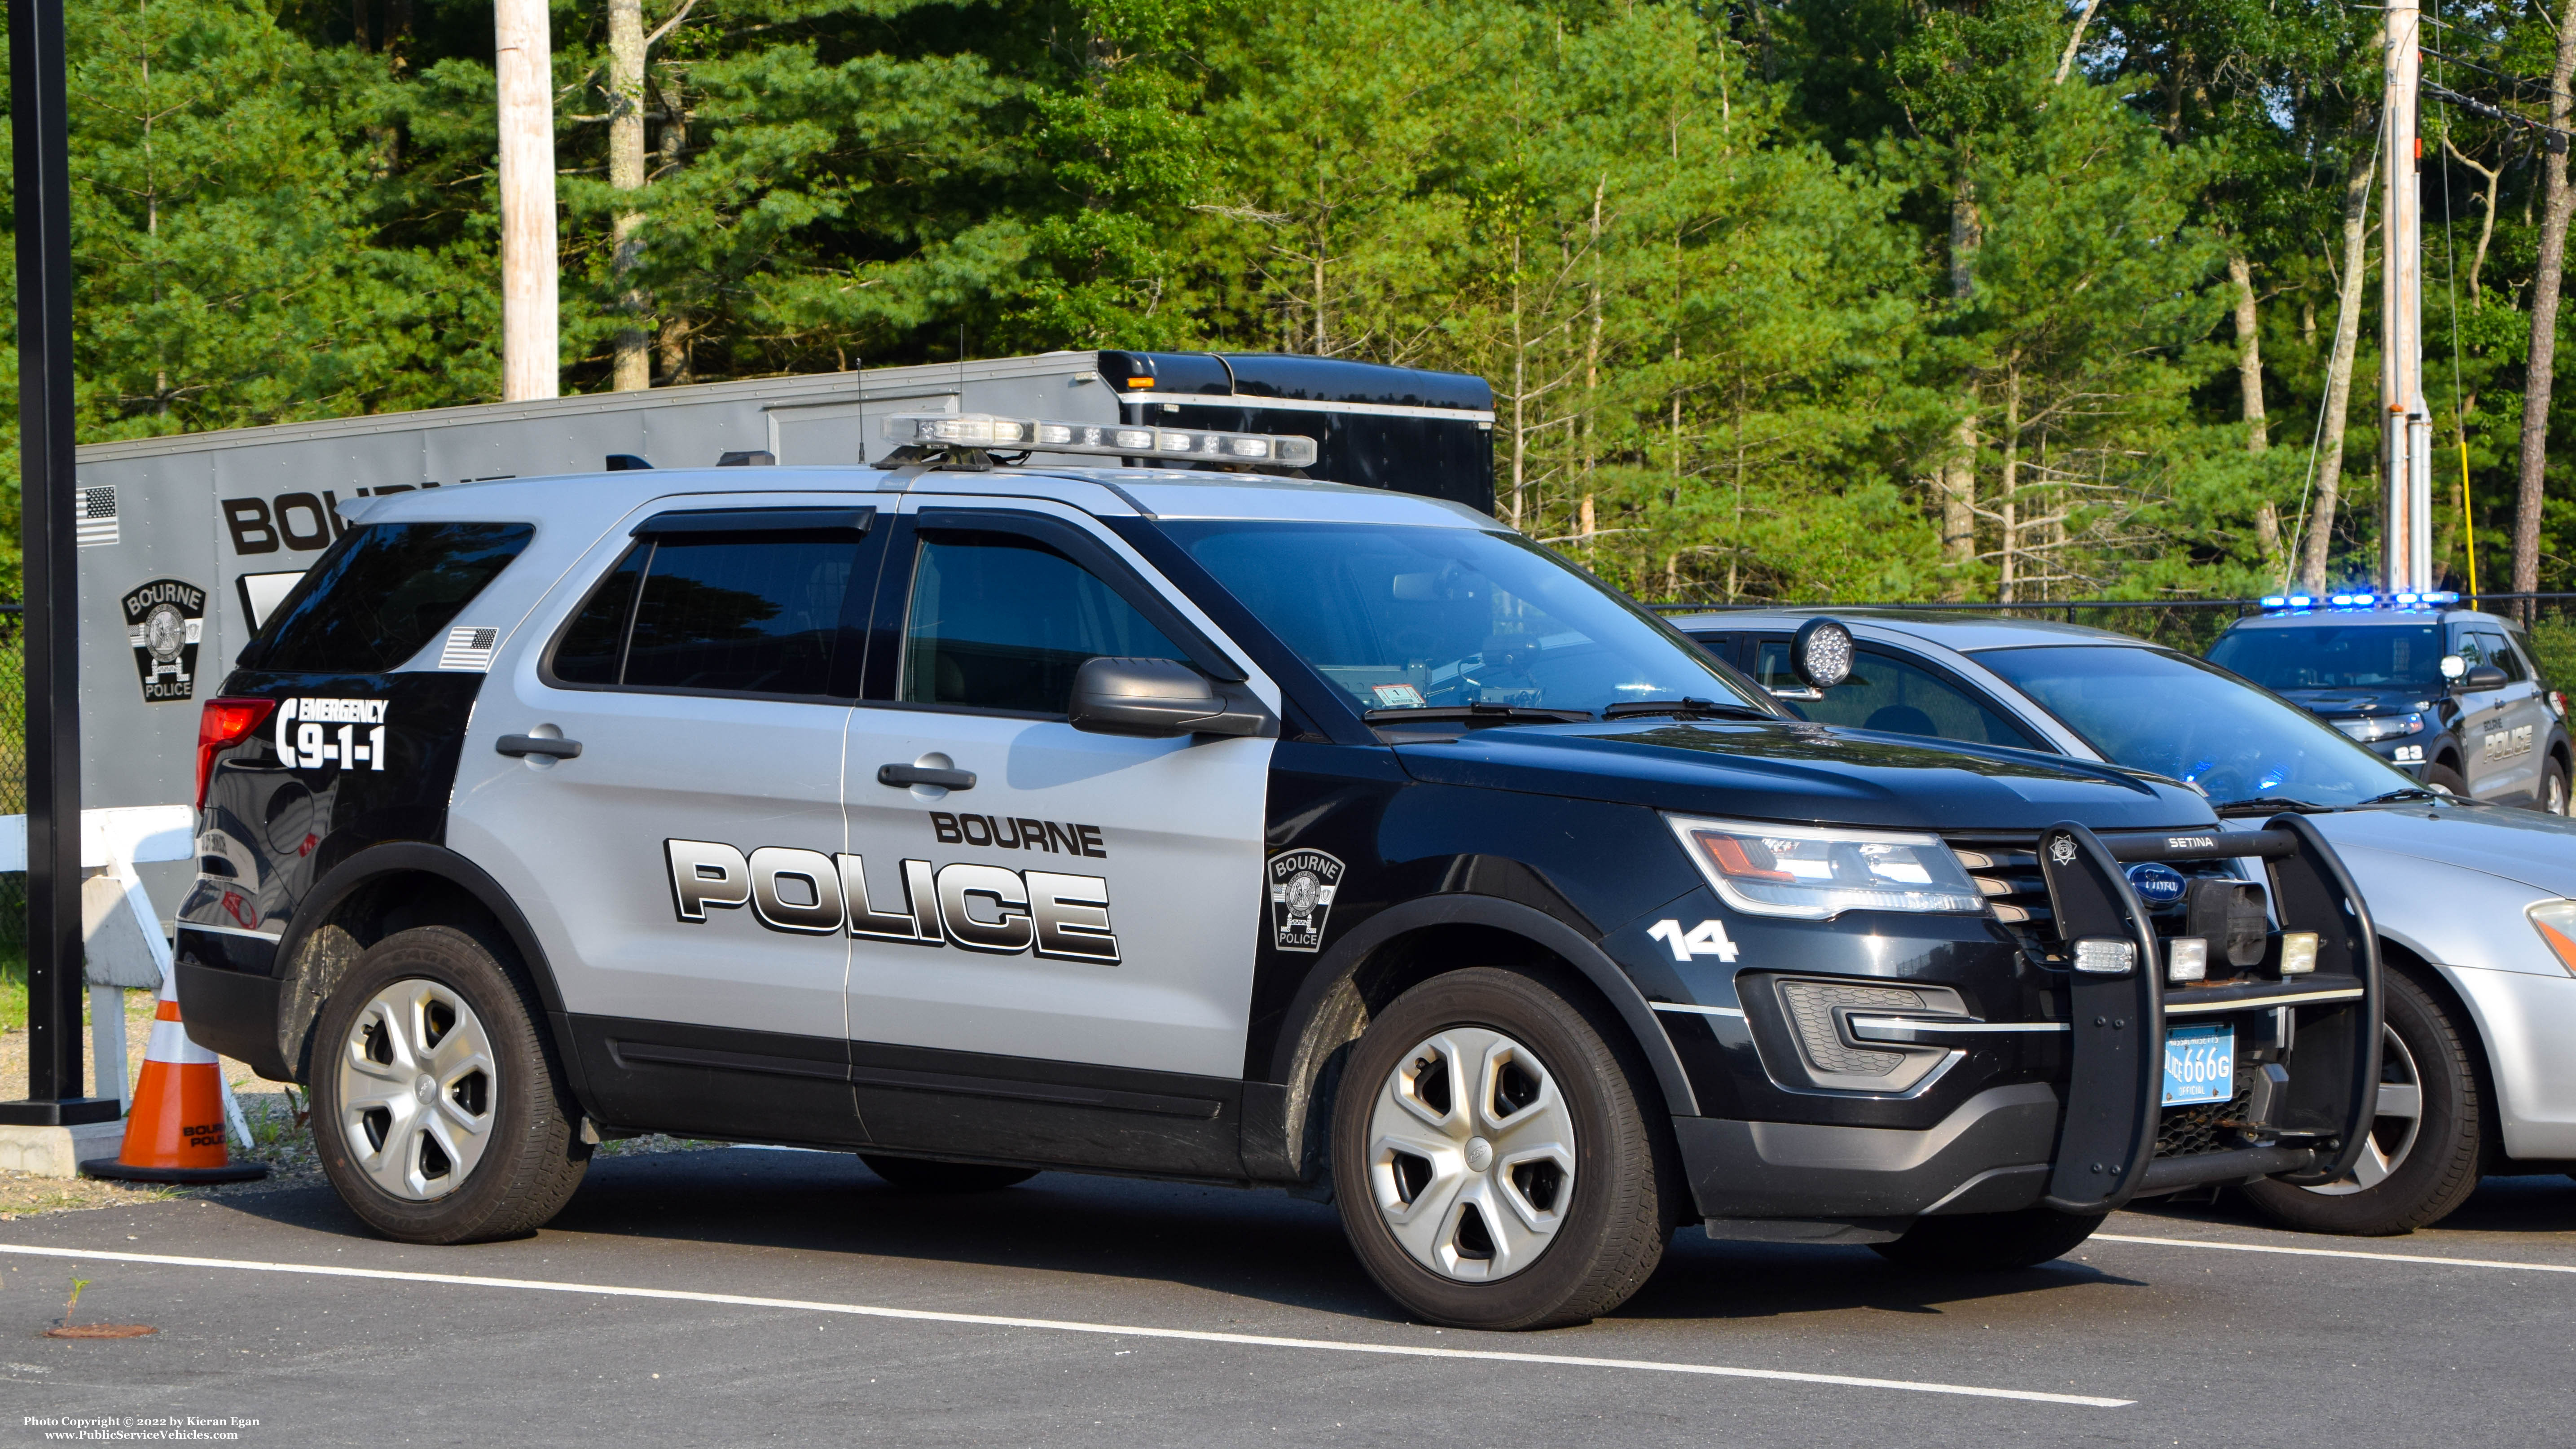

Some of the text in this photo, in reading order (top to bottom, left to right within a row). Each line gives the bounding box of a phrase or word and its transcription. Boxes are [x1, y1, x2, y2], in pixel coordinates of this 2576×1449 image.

[127, 584, 202, 616] BOURNE
[145, 682, 191, 697] POLICE
[299, 698, 388, 723] EMERGENCY
[297, 723, 385, 770] 9-1-1
[2394, 745, 2423, 761] 23
[2484, 724, 2532, 764] POLICE
[929, 811, 1107, 858] BOURNE
[2168, 837, 2214, 847] SETINA
[1275, 856, 1338, 879] BOURNE
[1288, 874, 1299, 887] TOWN
[1307, 872, 1319, 888] BOURNE
[663, 838, 1122, 966] POLICE
[1279, 934, 1317, 945] POLICE
[1647, 919, 1739, 962] 14
[2169, 1034, 2219, 1046] MASSACHUSETTS
[2165, 1050, 2183, 1083] OLICE
[2179, 1086, 2205, 1096] OFFICIAL
